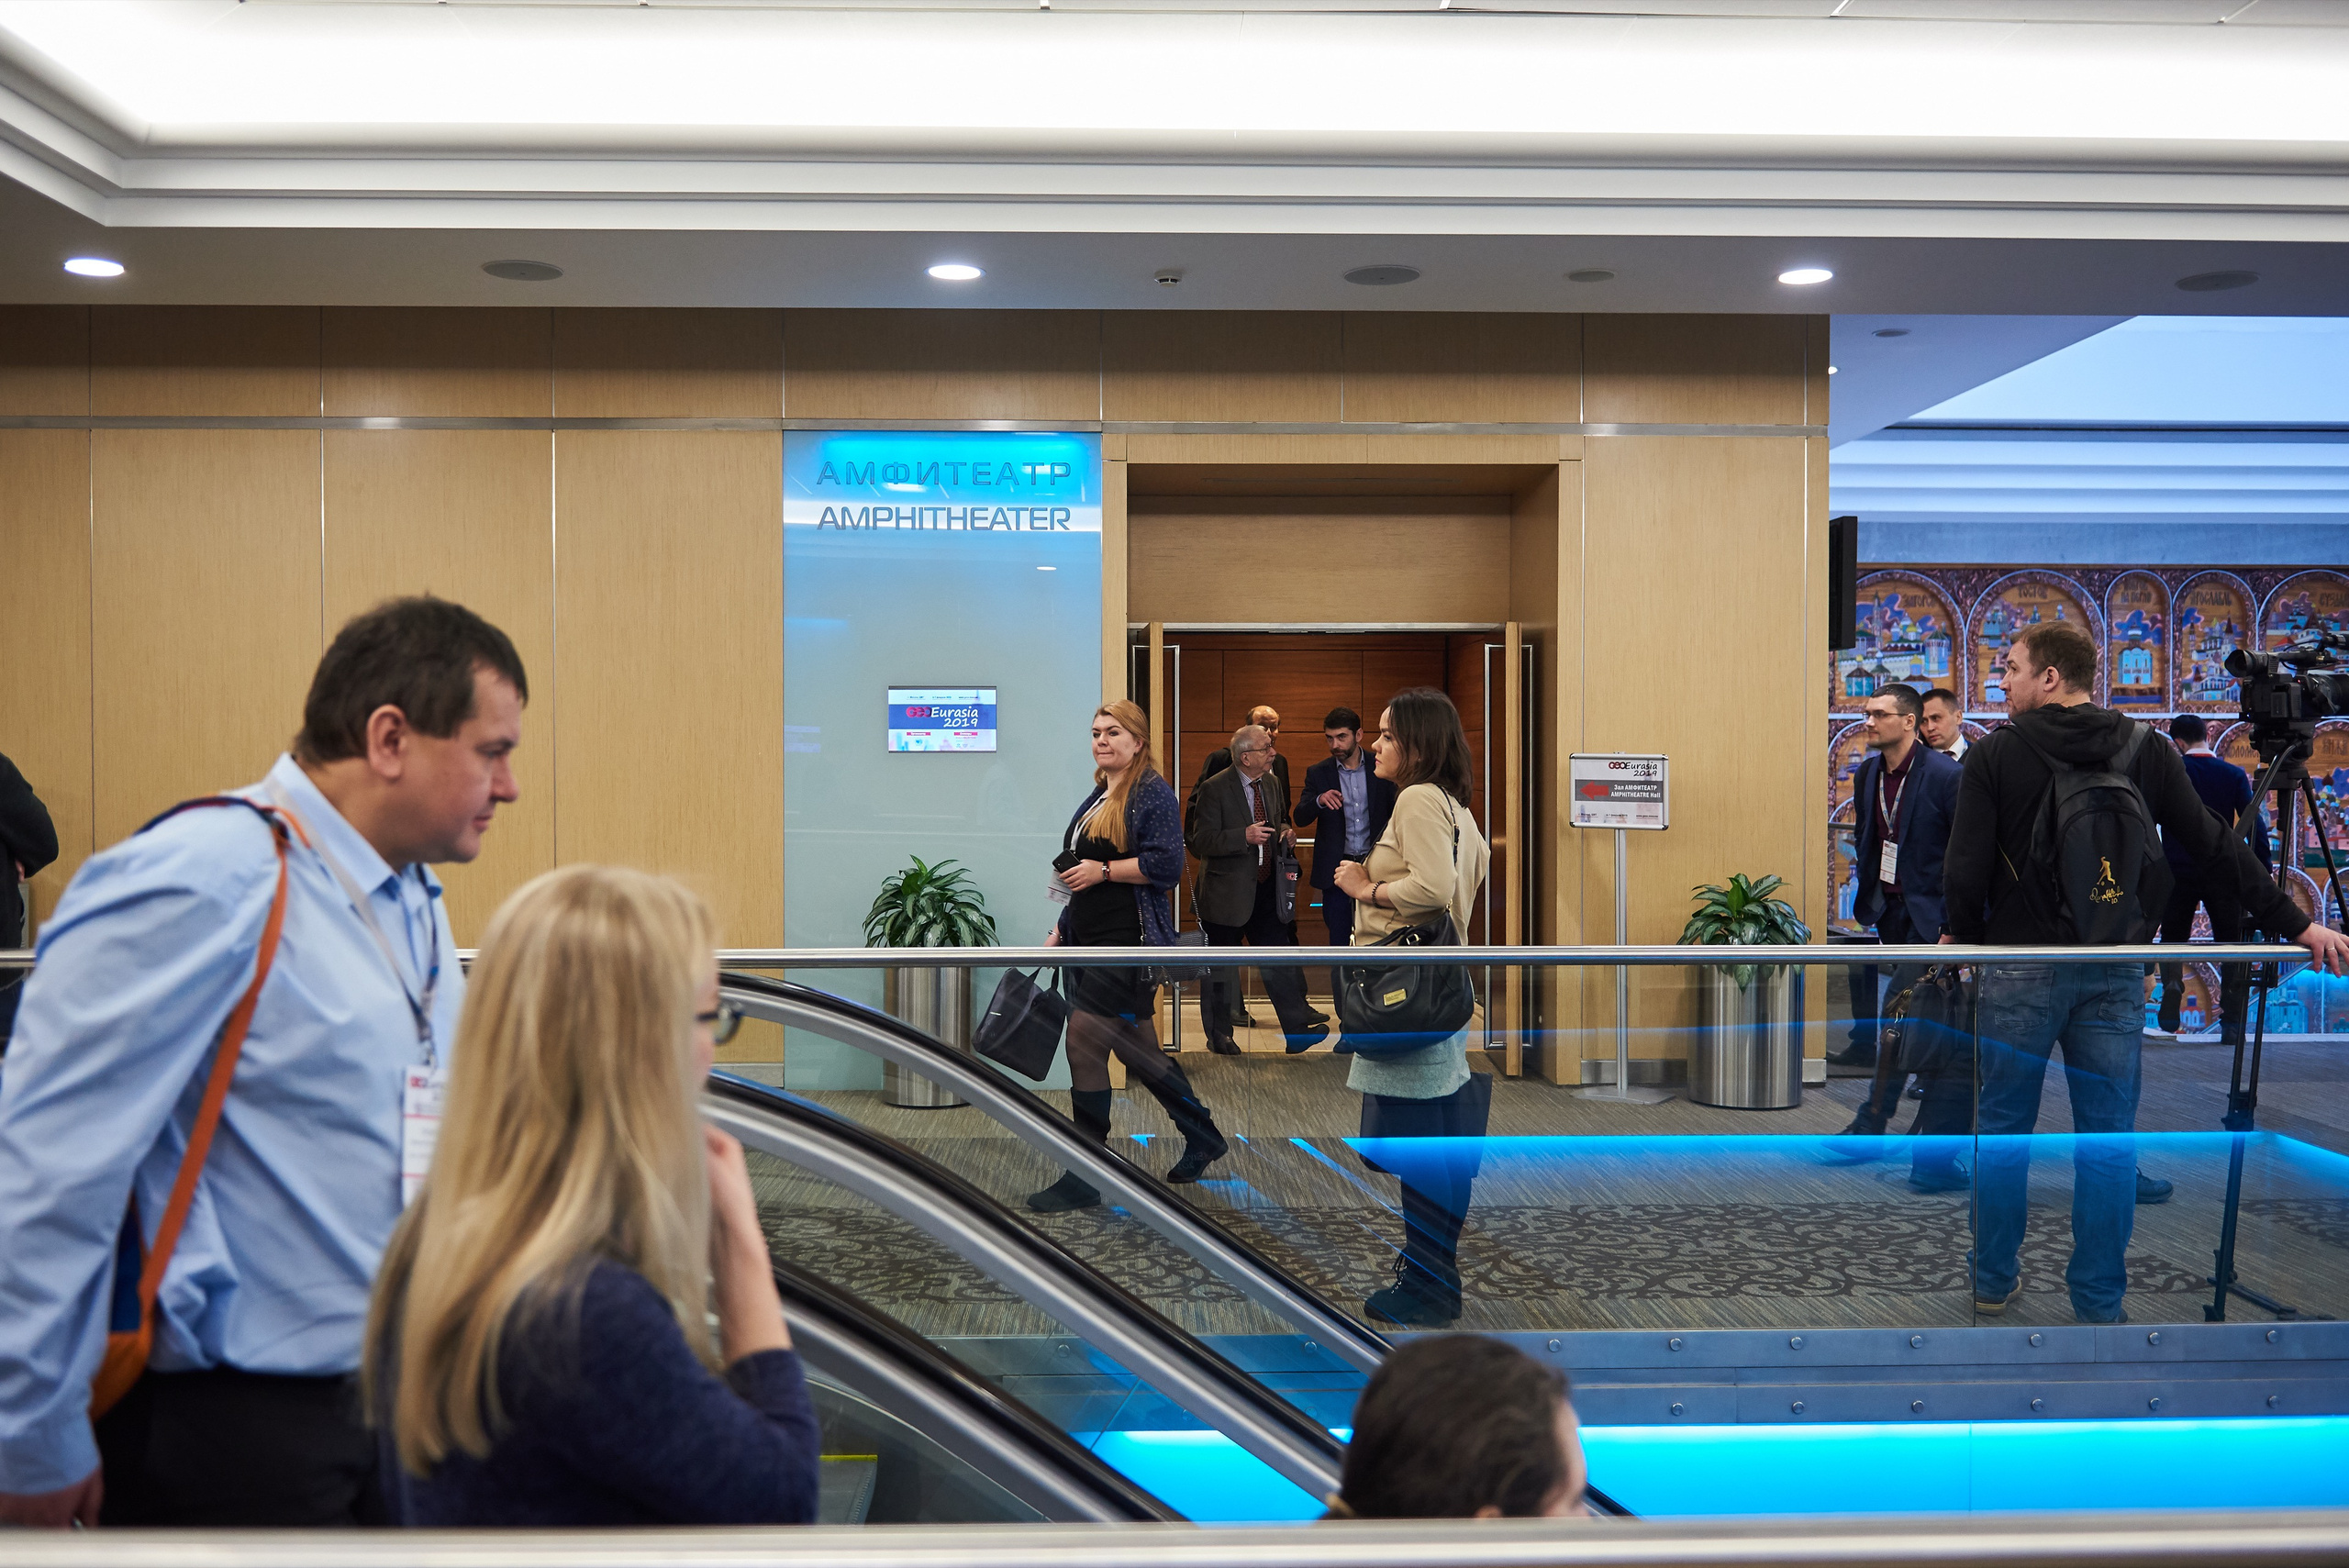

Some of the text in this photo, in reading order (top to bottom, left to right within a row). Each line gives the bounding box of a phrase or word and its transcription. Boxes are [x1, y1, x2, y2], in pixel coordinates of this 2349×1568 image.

[816, 461, 1072, 485] АМФИТЕАТР
[817, 506, 1071, 531] AMPHITHEATER
[943, 717, 978, 728] 2019
